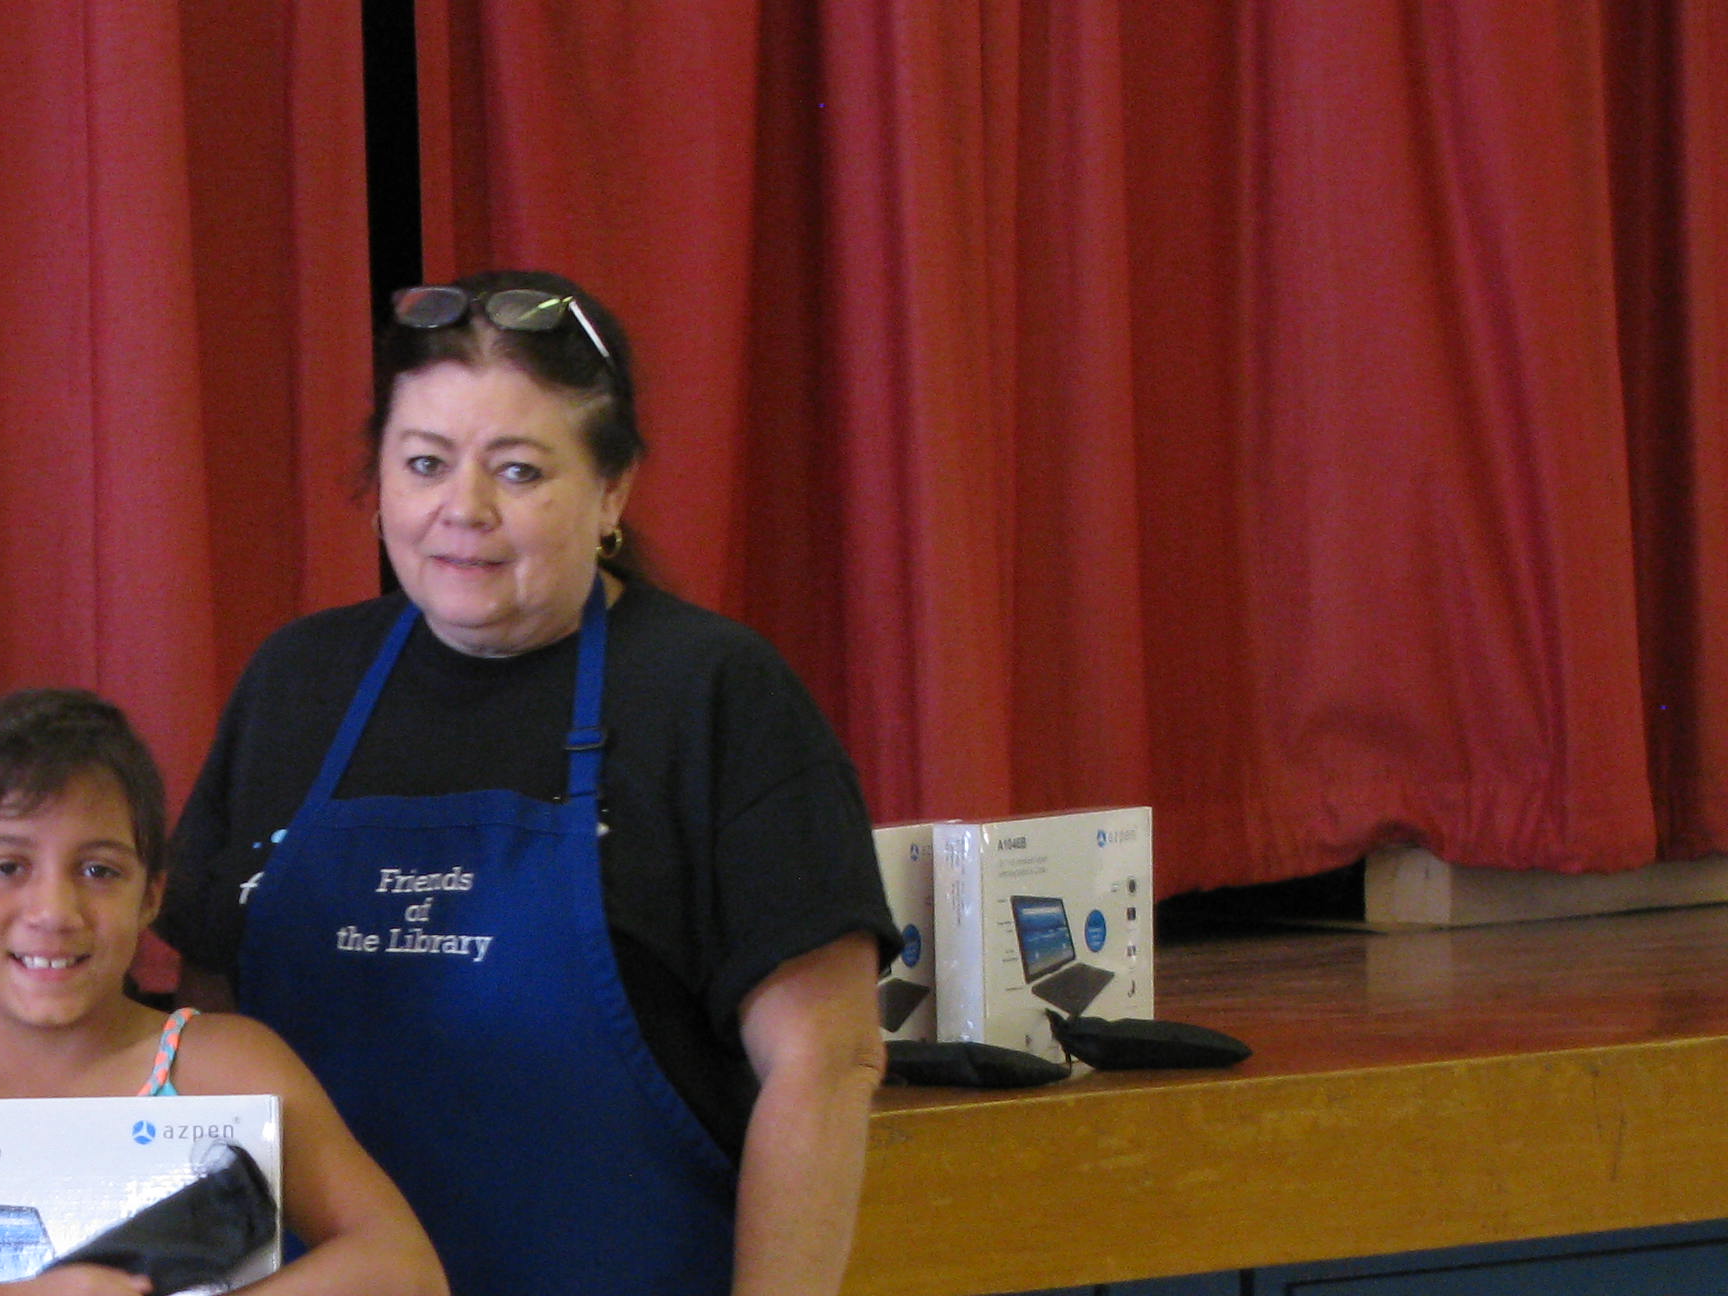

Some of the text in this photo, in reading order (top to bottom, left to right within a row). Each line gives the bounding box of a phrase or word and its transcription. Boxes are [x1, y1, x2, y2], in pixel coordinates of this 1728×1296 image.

[375, 865, 475, 893] Friends
[404, 897, 434, 922] of
[336, 925, 494, 962] the Library
[162, 1123, 235, 1143] azpen
